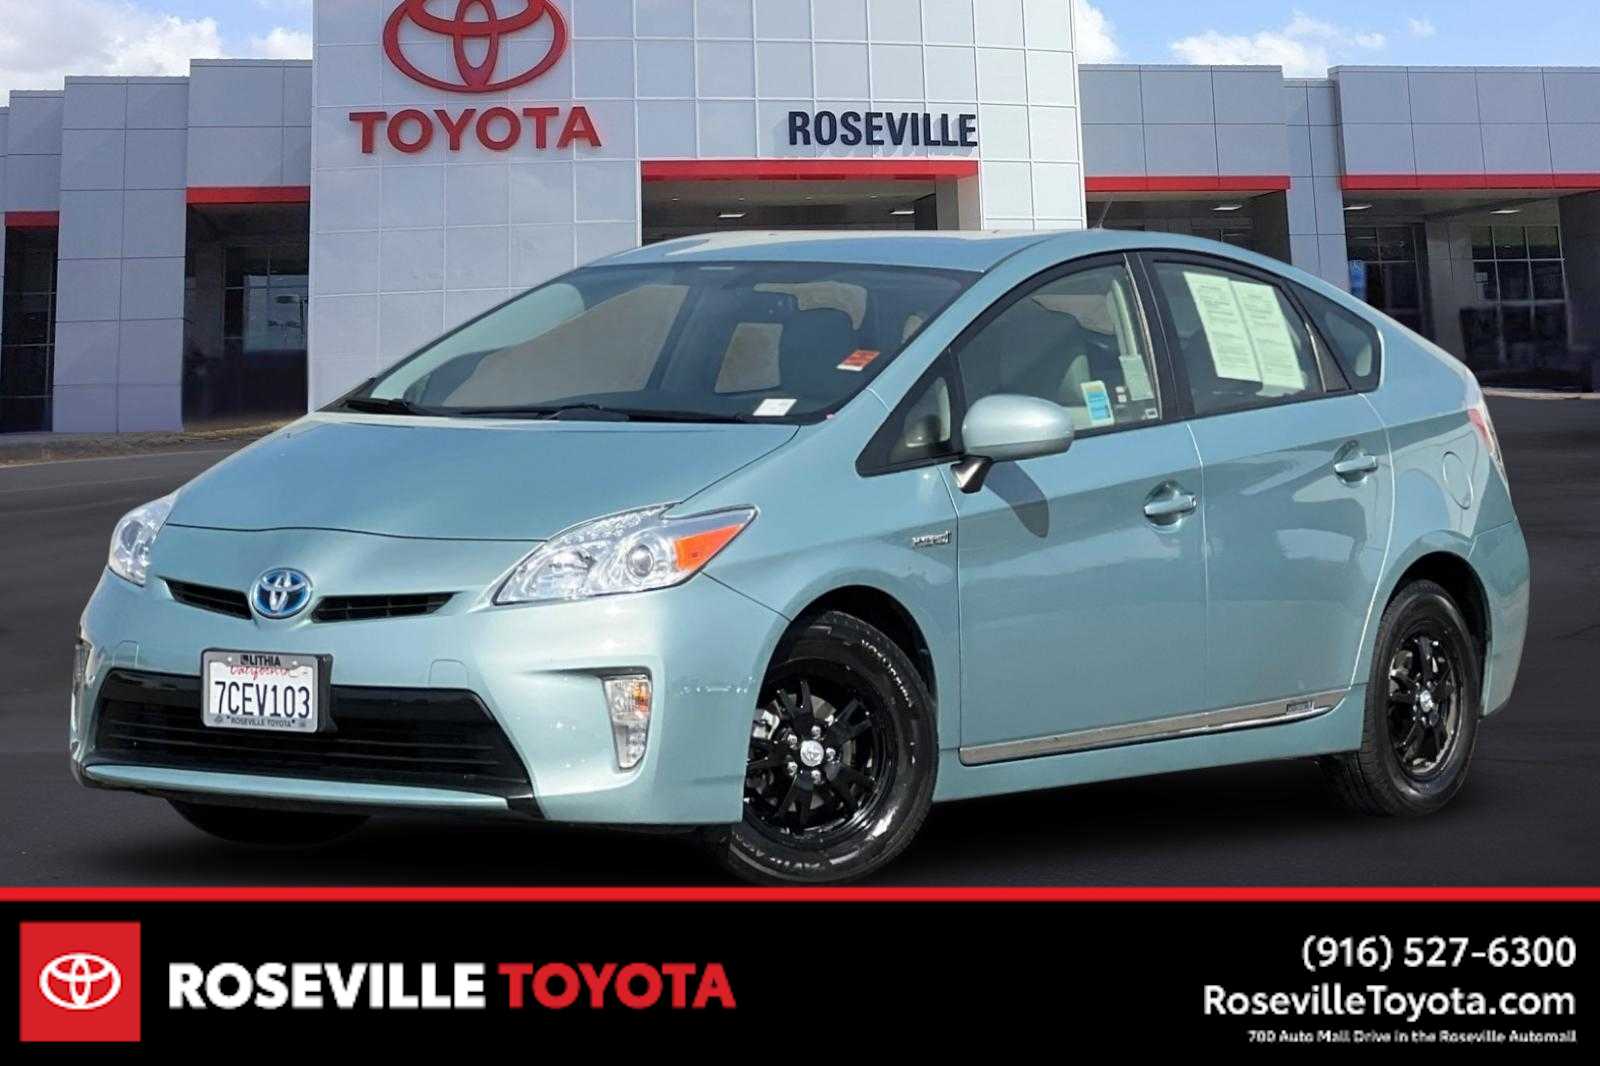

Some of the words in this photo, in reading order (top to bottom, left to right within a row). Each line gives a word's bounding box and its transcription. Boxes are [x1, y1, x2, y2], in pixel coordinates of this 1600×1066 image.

[348, 106, 602, 154] TOYOTA
[788, 111, 978, 147] ROSEVILLE
[249, 654, 281, 667] LITHIA
[214, 681, 310, 719] 7CEV103
